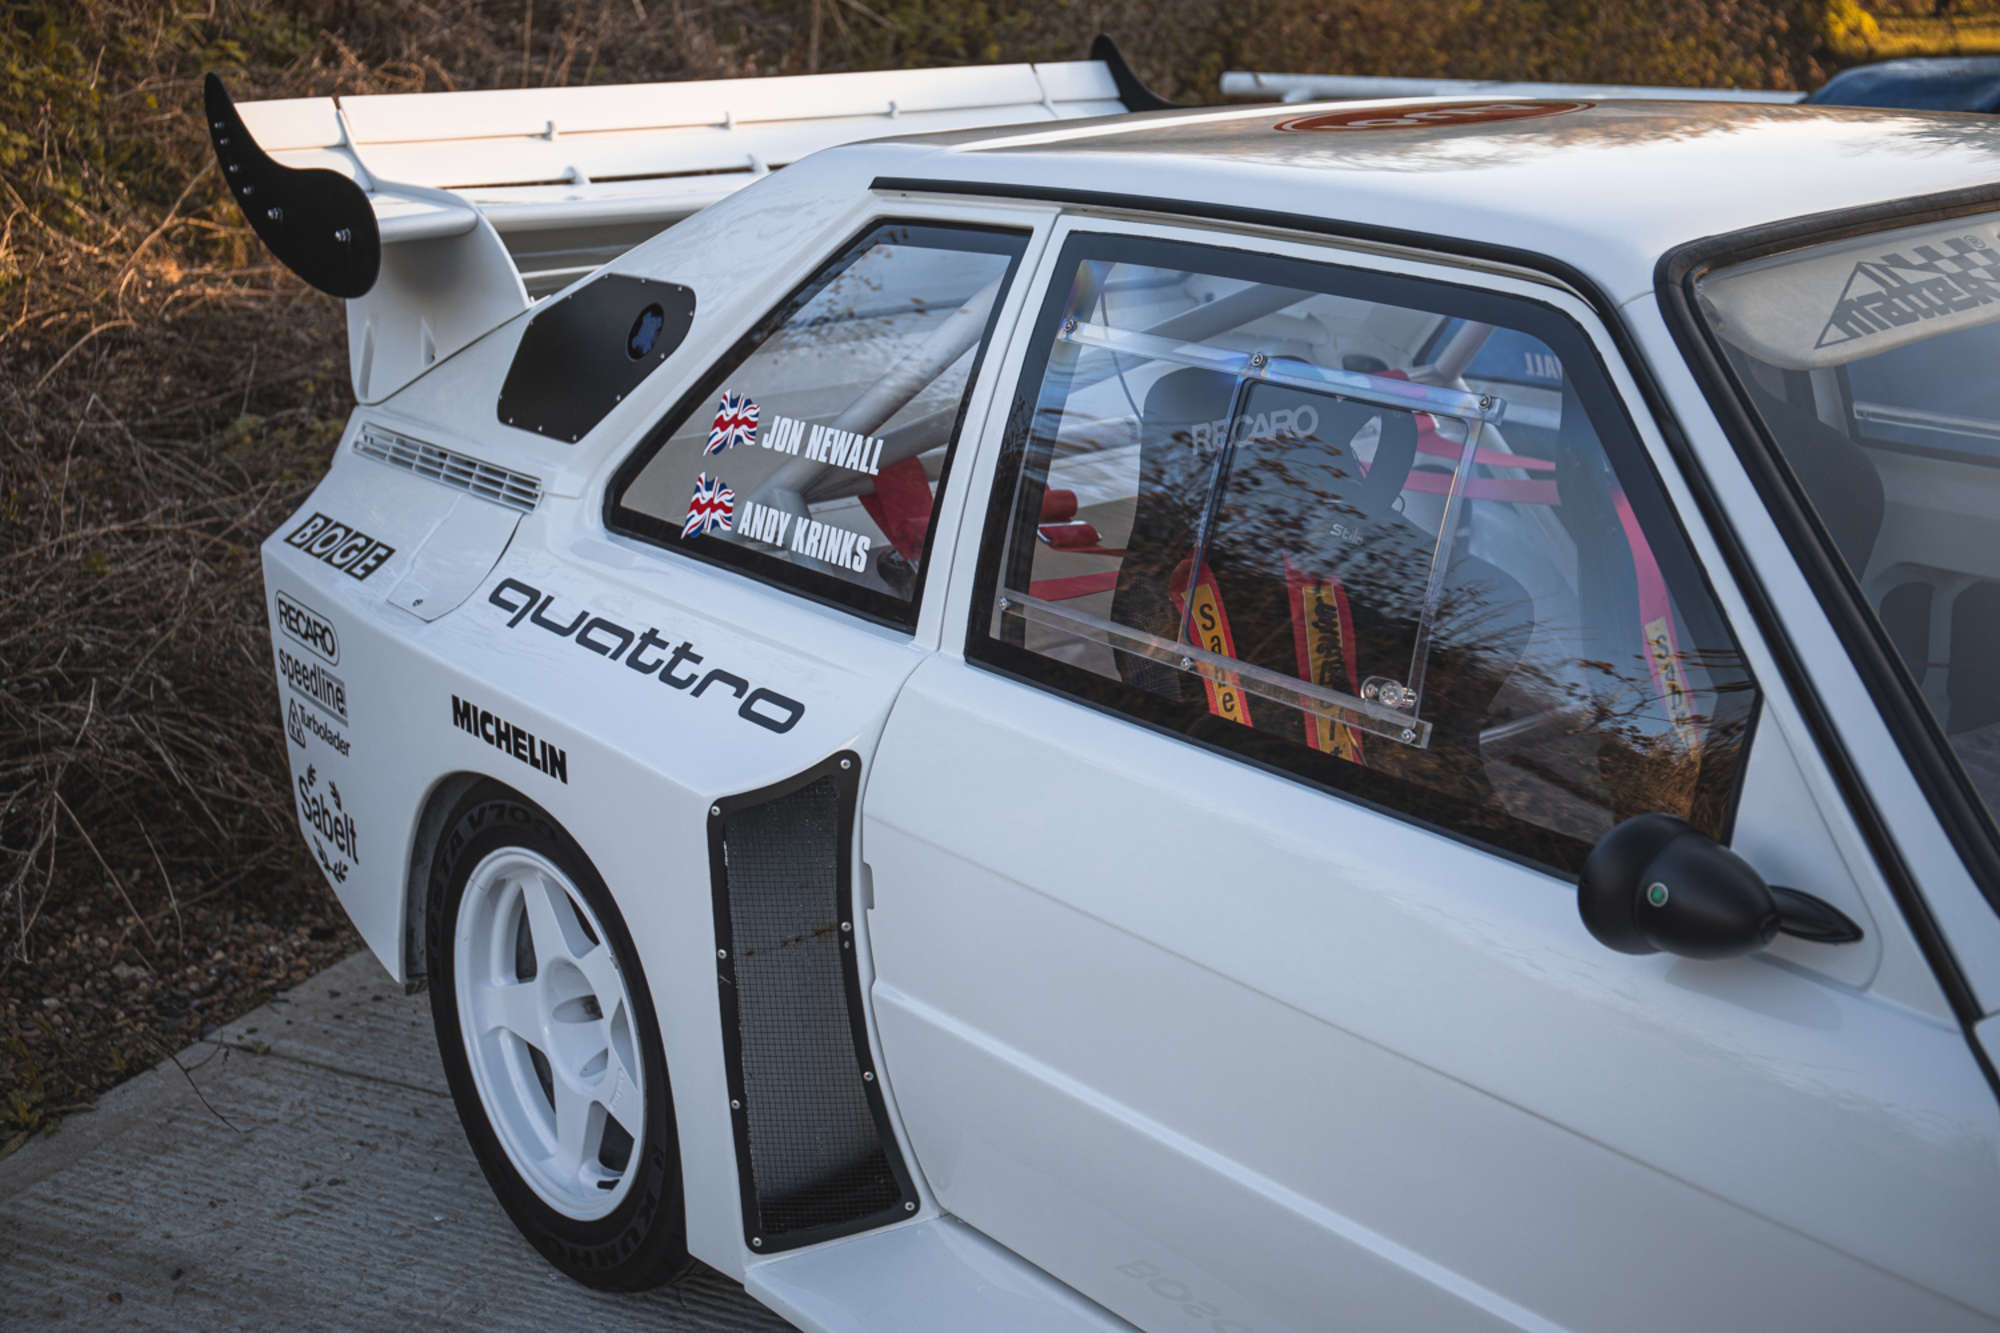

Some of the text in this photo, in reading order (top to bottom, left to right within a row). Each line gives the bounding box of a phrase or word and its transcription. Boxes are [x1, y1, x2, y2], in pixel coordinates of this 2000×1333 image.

[761, 415, 884, 476] JON NEWALL
[1192, 404, 1320, 456] RECARO
[287, 513, 391, 580] BOGE
[737, 501, 872, 573] ANDY KRINKS
[277, 598, 337, 657] RECARO
[488, 577, 806, 734] quattro
[279, 648, 346, 715] speedline
[298, 703, 350, 757] Turbolader
[451, 694, 569, 785] MICHELIN
[298, 774, 360, 865] Sabelt
